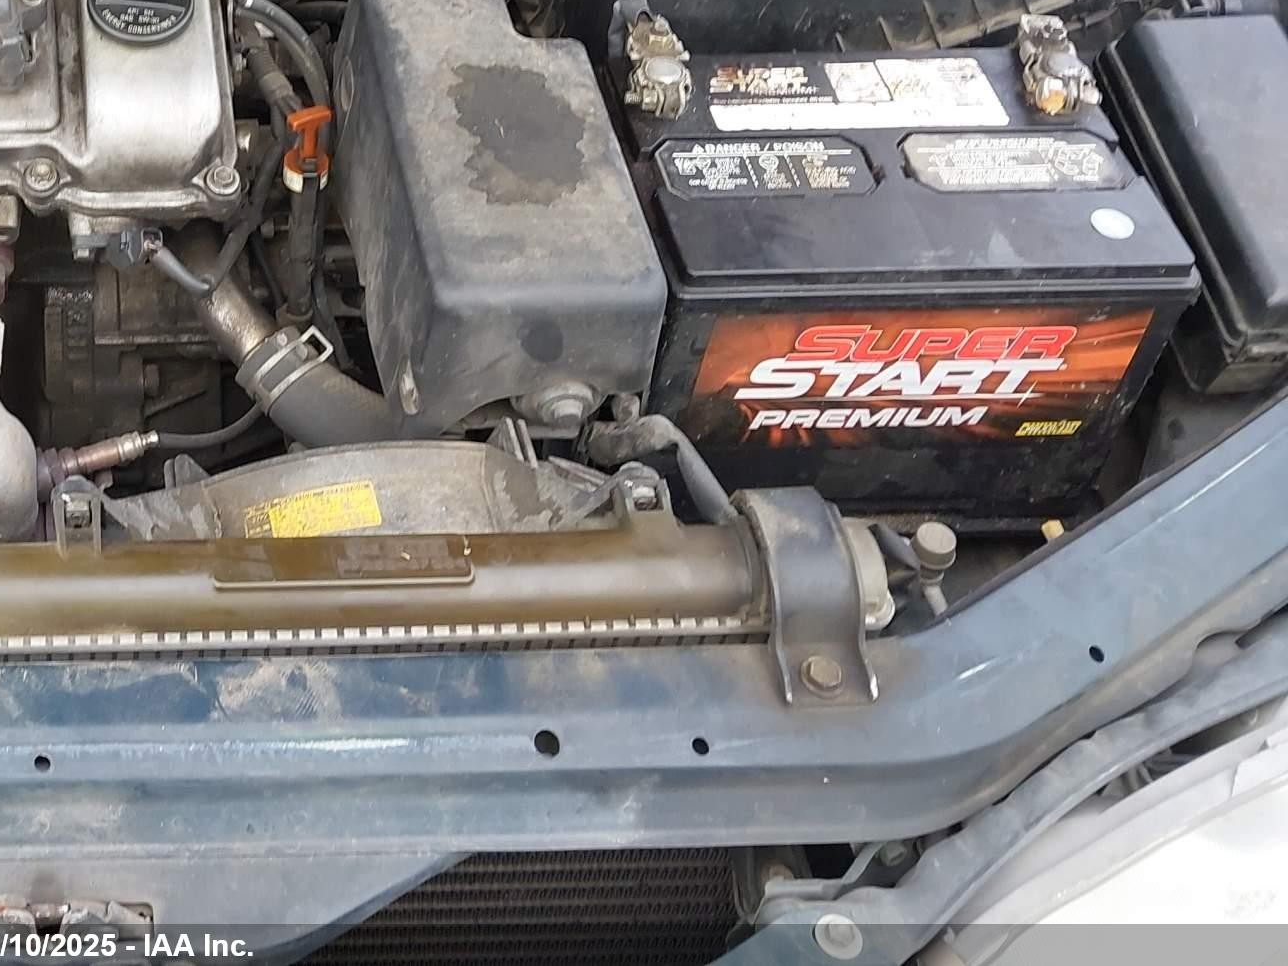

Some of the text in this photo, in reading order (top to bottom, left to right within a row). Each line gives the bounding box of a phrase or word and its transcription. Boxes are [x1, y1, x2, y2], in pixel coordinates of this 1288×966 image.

[785, 325, 1078, 362] SUPER
[735, 358, 1065, 400] START
[748, 406, 989, 431] PREMIUM
